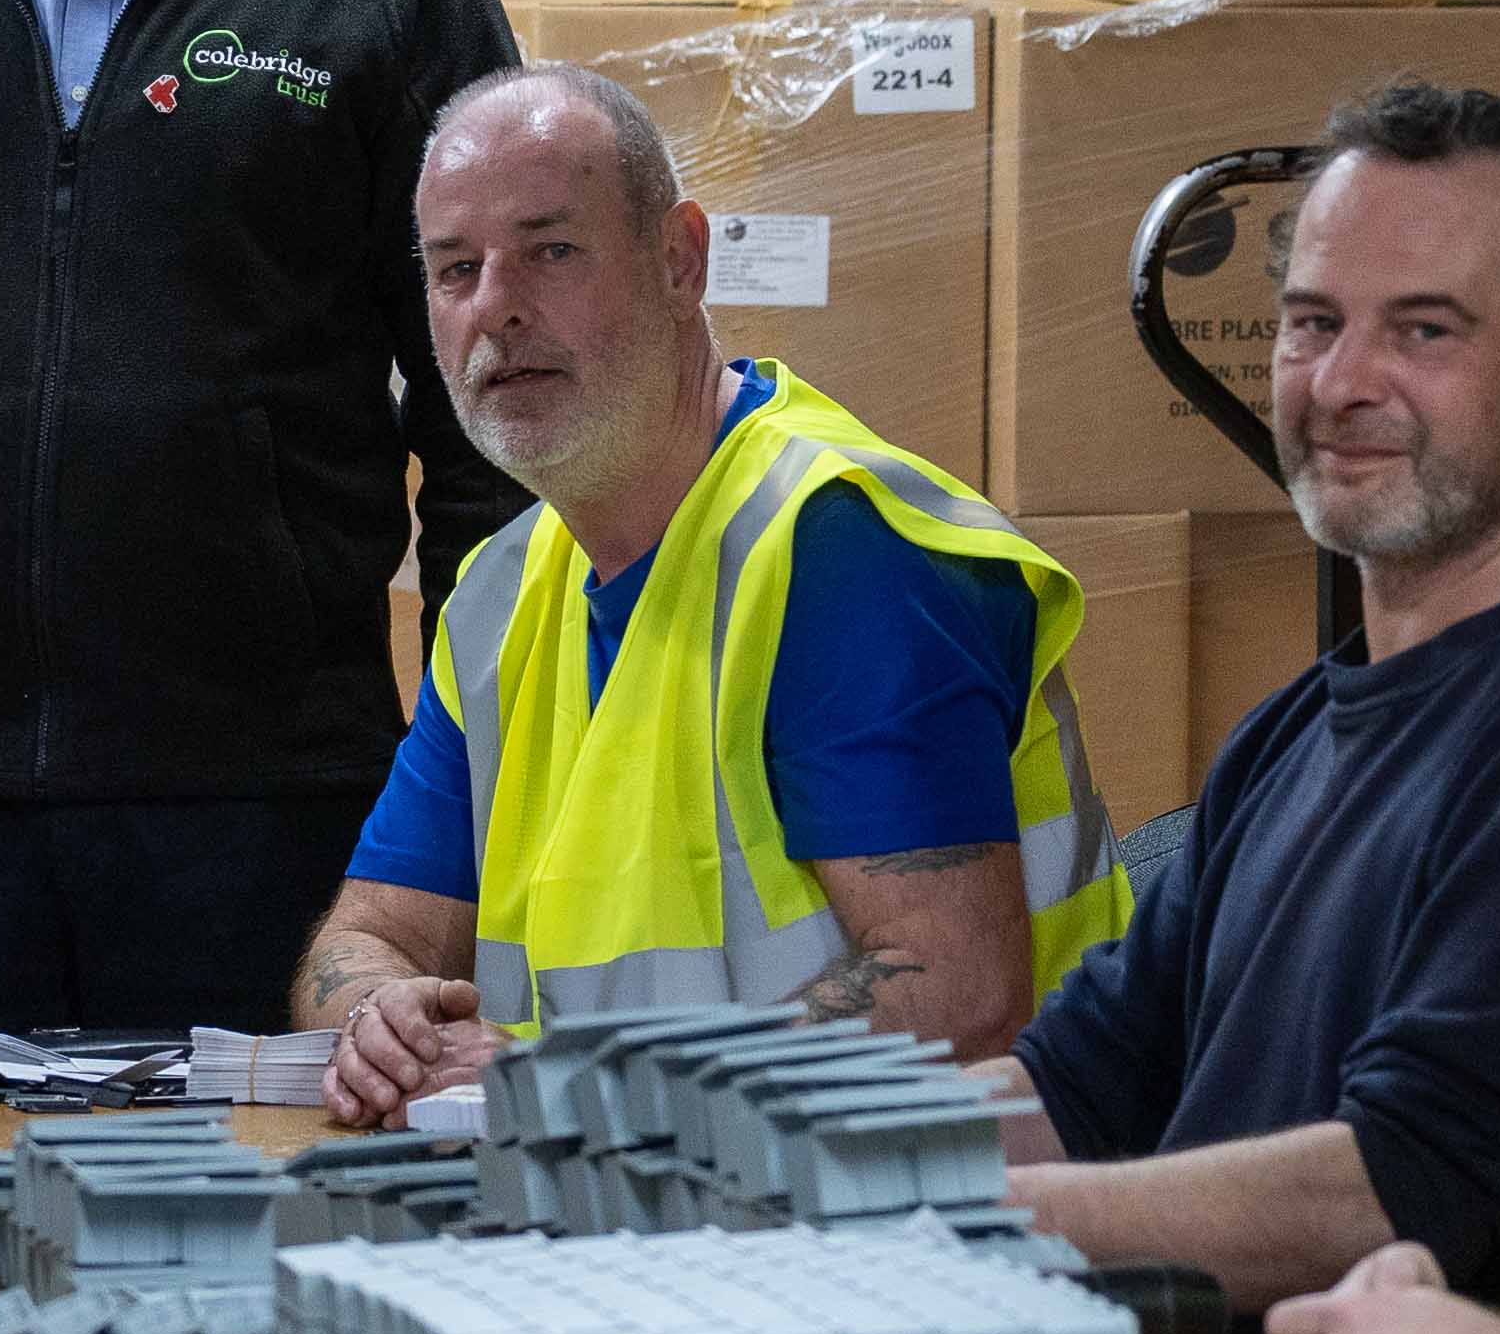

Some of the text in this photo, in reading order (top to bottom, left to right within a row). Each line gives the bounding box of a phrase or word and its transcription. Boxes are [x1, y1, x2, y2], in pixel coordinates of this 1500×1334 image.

[194, 46, 332, 87] colebridge
[872, 68, 954, 91] 221-4
[277, 75, 329, 108] trust
